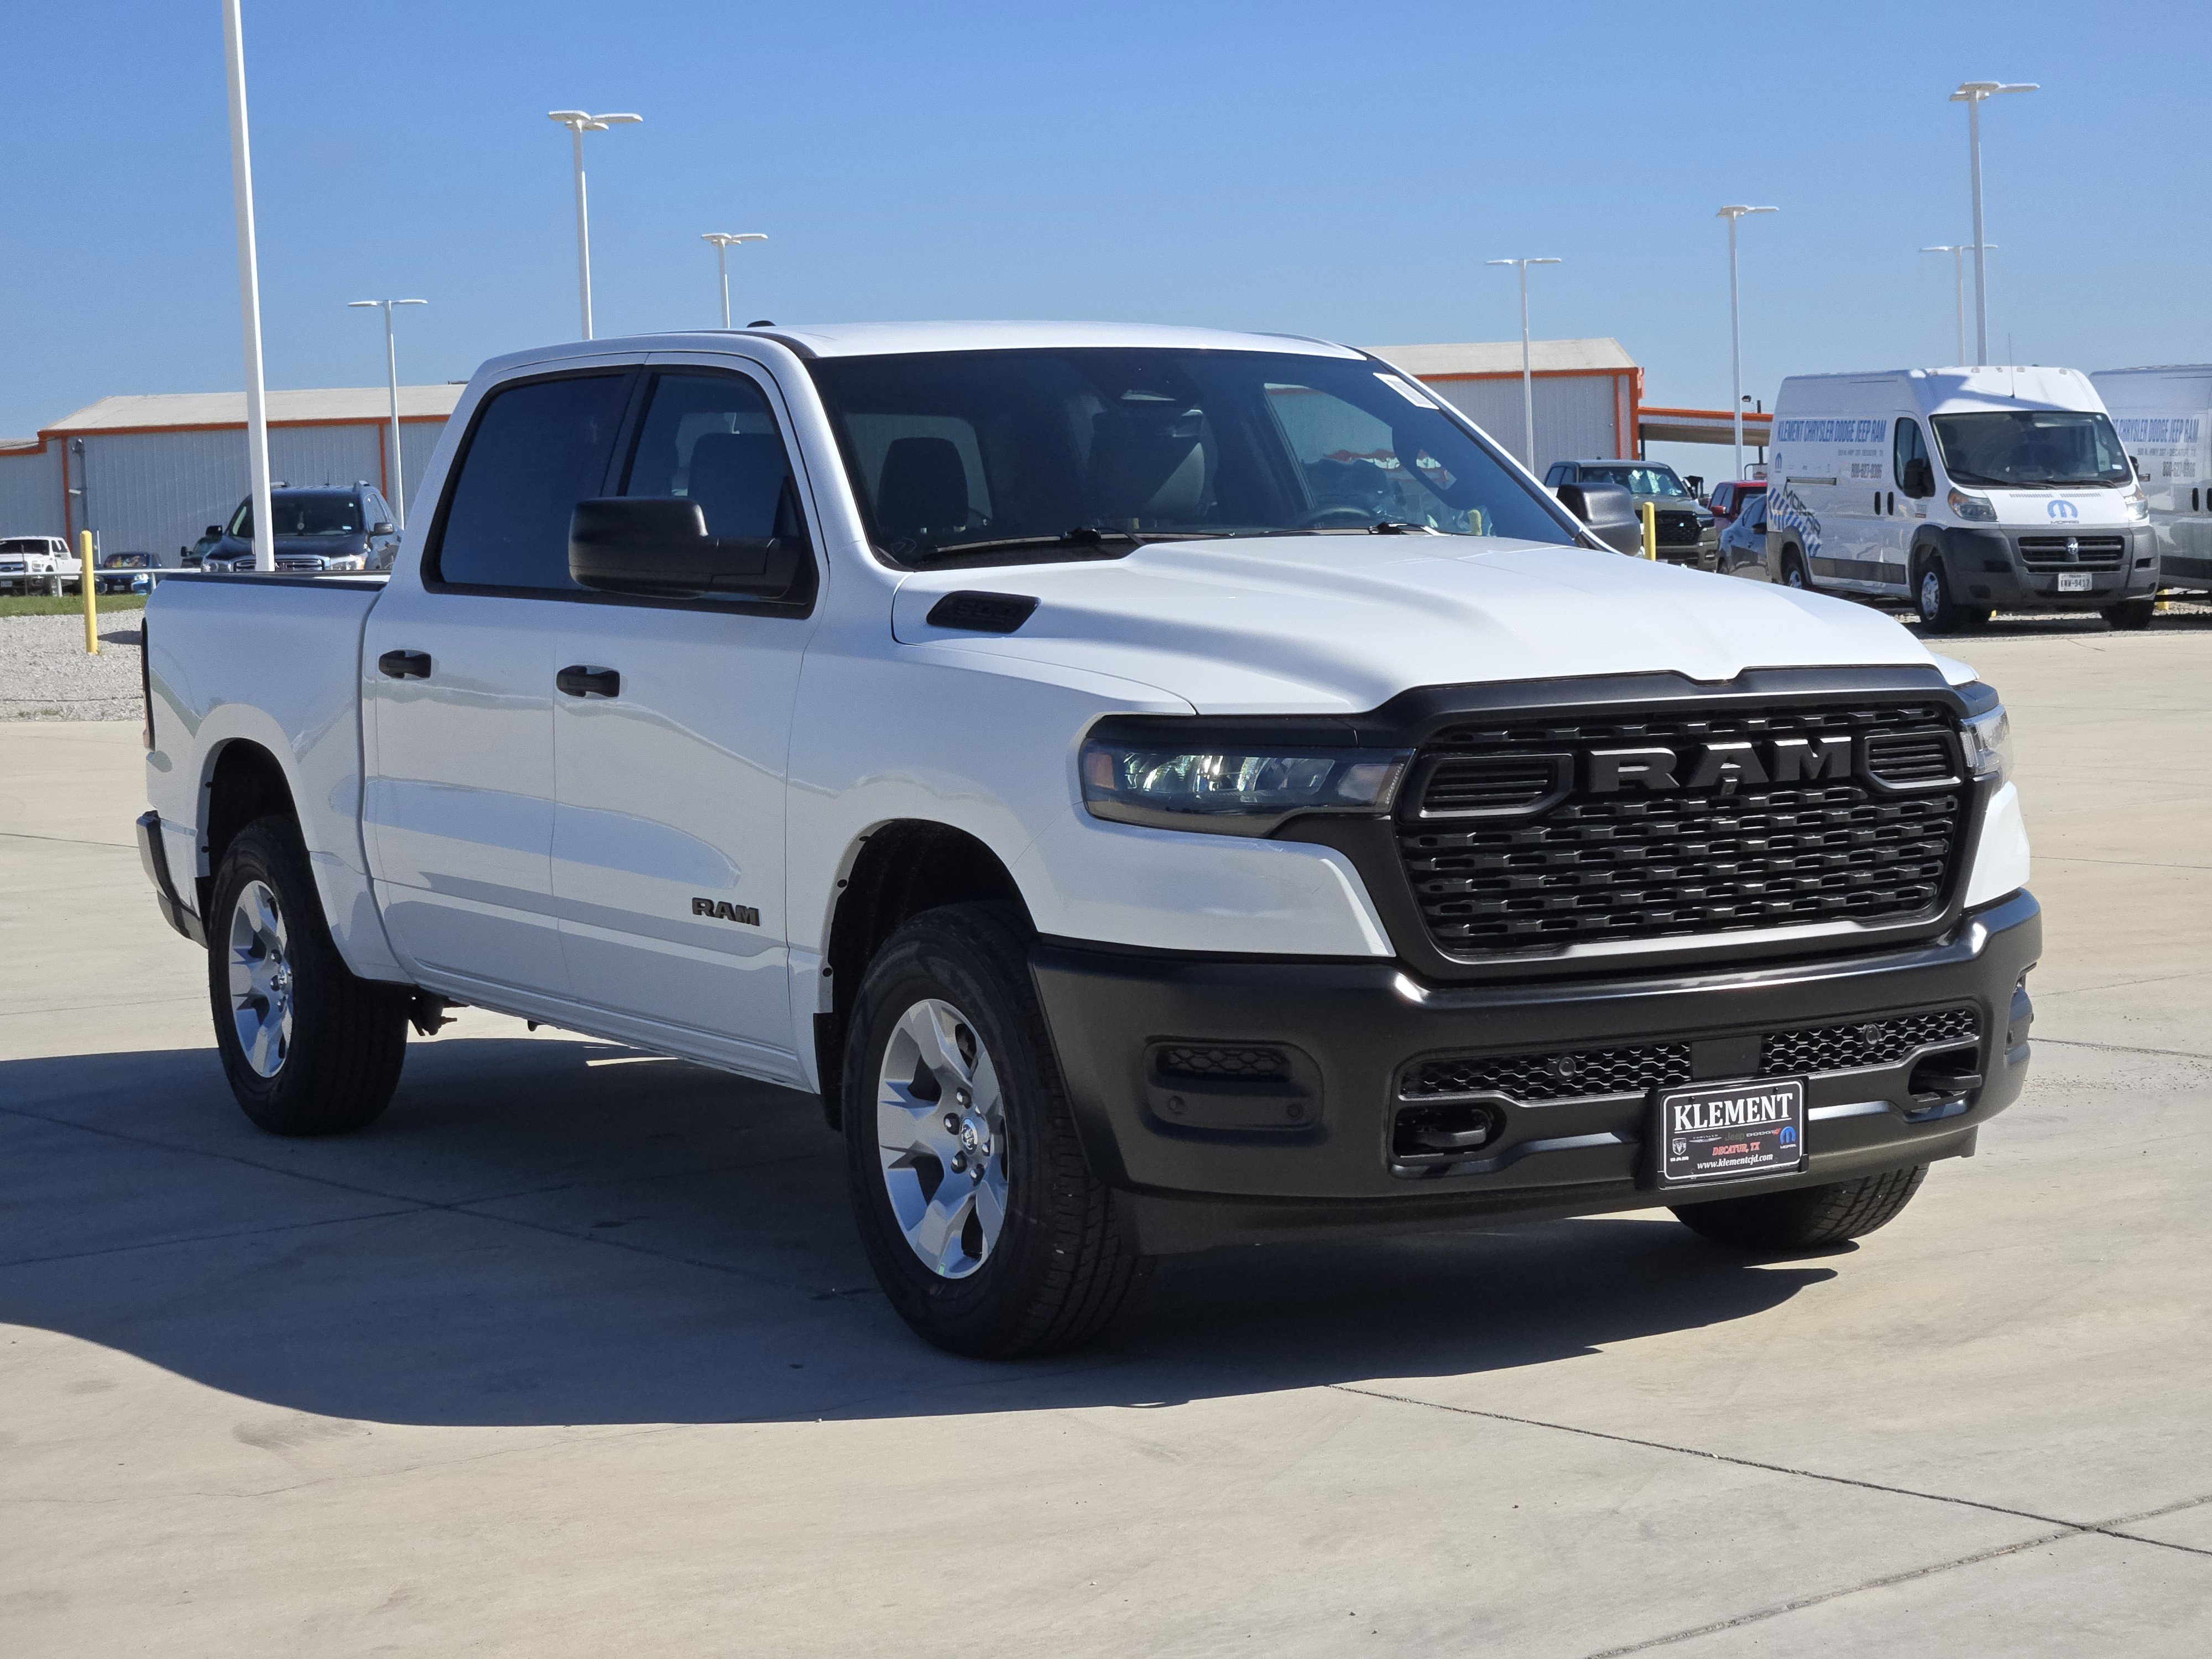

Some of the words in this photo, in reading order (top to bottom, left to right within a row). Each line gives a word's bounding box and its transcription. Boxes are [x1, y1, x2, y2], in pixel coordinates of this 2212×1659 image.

[1777, 420, 1805, 442] KLEMENT
[1804, 420, 1834, 442] CHRYSLER
[1834, 420, 1855, 442] DODGE
[1855, 420, 1871, 442] JEEP
[1871, 420, 1886, 442] RAM
[2148, 419, 2169, 442] DODGE
[2169, 419, 2184, 442] JEEP
[2184, 419, 2199, 442] RAM
[1589, 736, 1851, 792] RAM
[692, 897, 760, 926] RAM
[1674, 1093, 1793, 1131] KLEMENT
[1725, 1131, 1745, 1141] Jeep
[1750, 1141, 1761, 1151] TX
[1697, 1154, 1773, 1170] www.klementcjd.com
